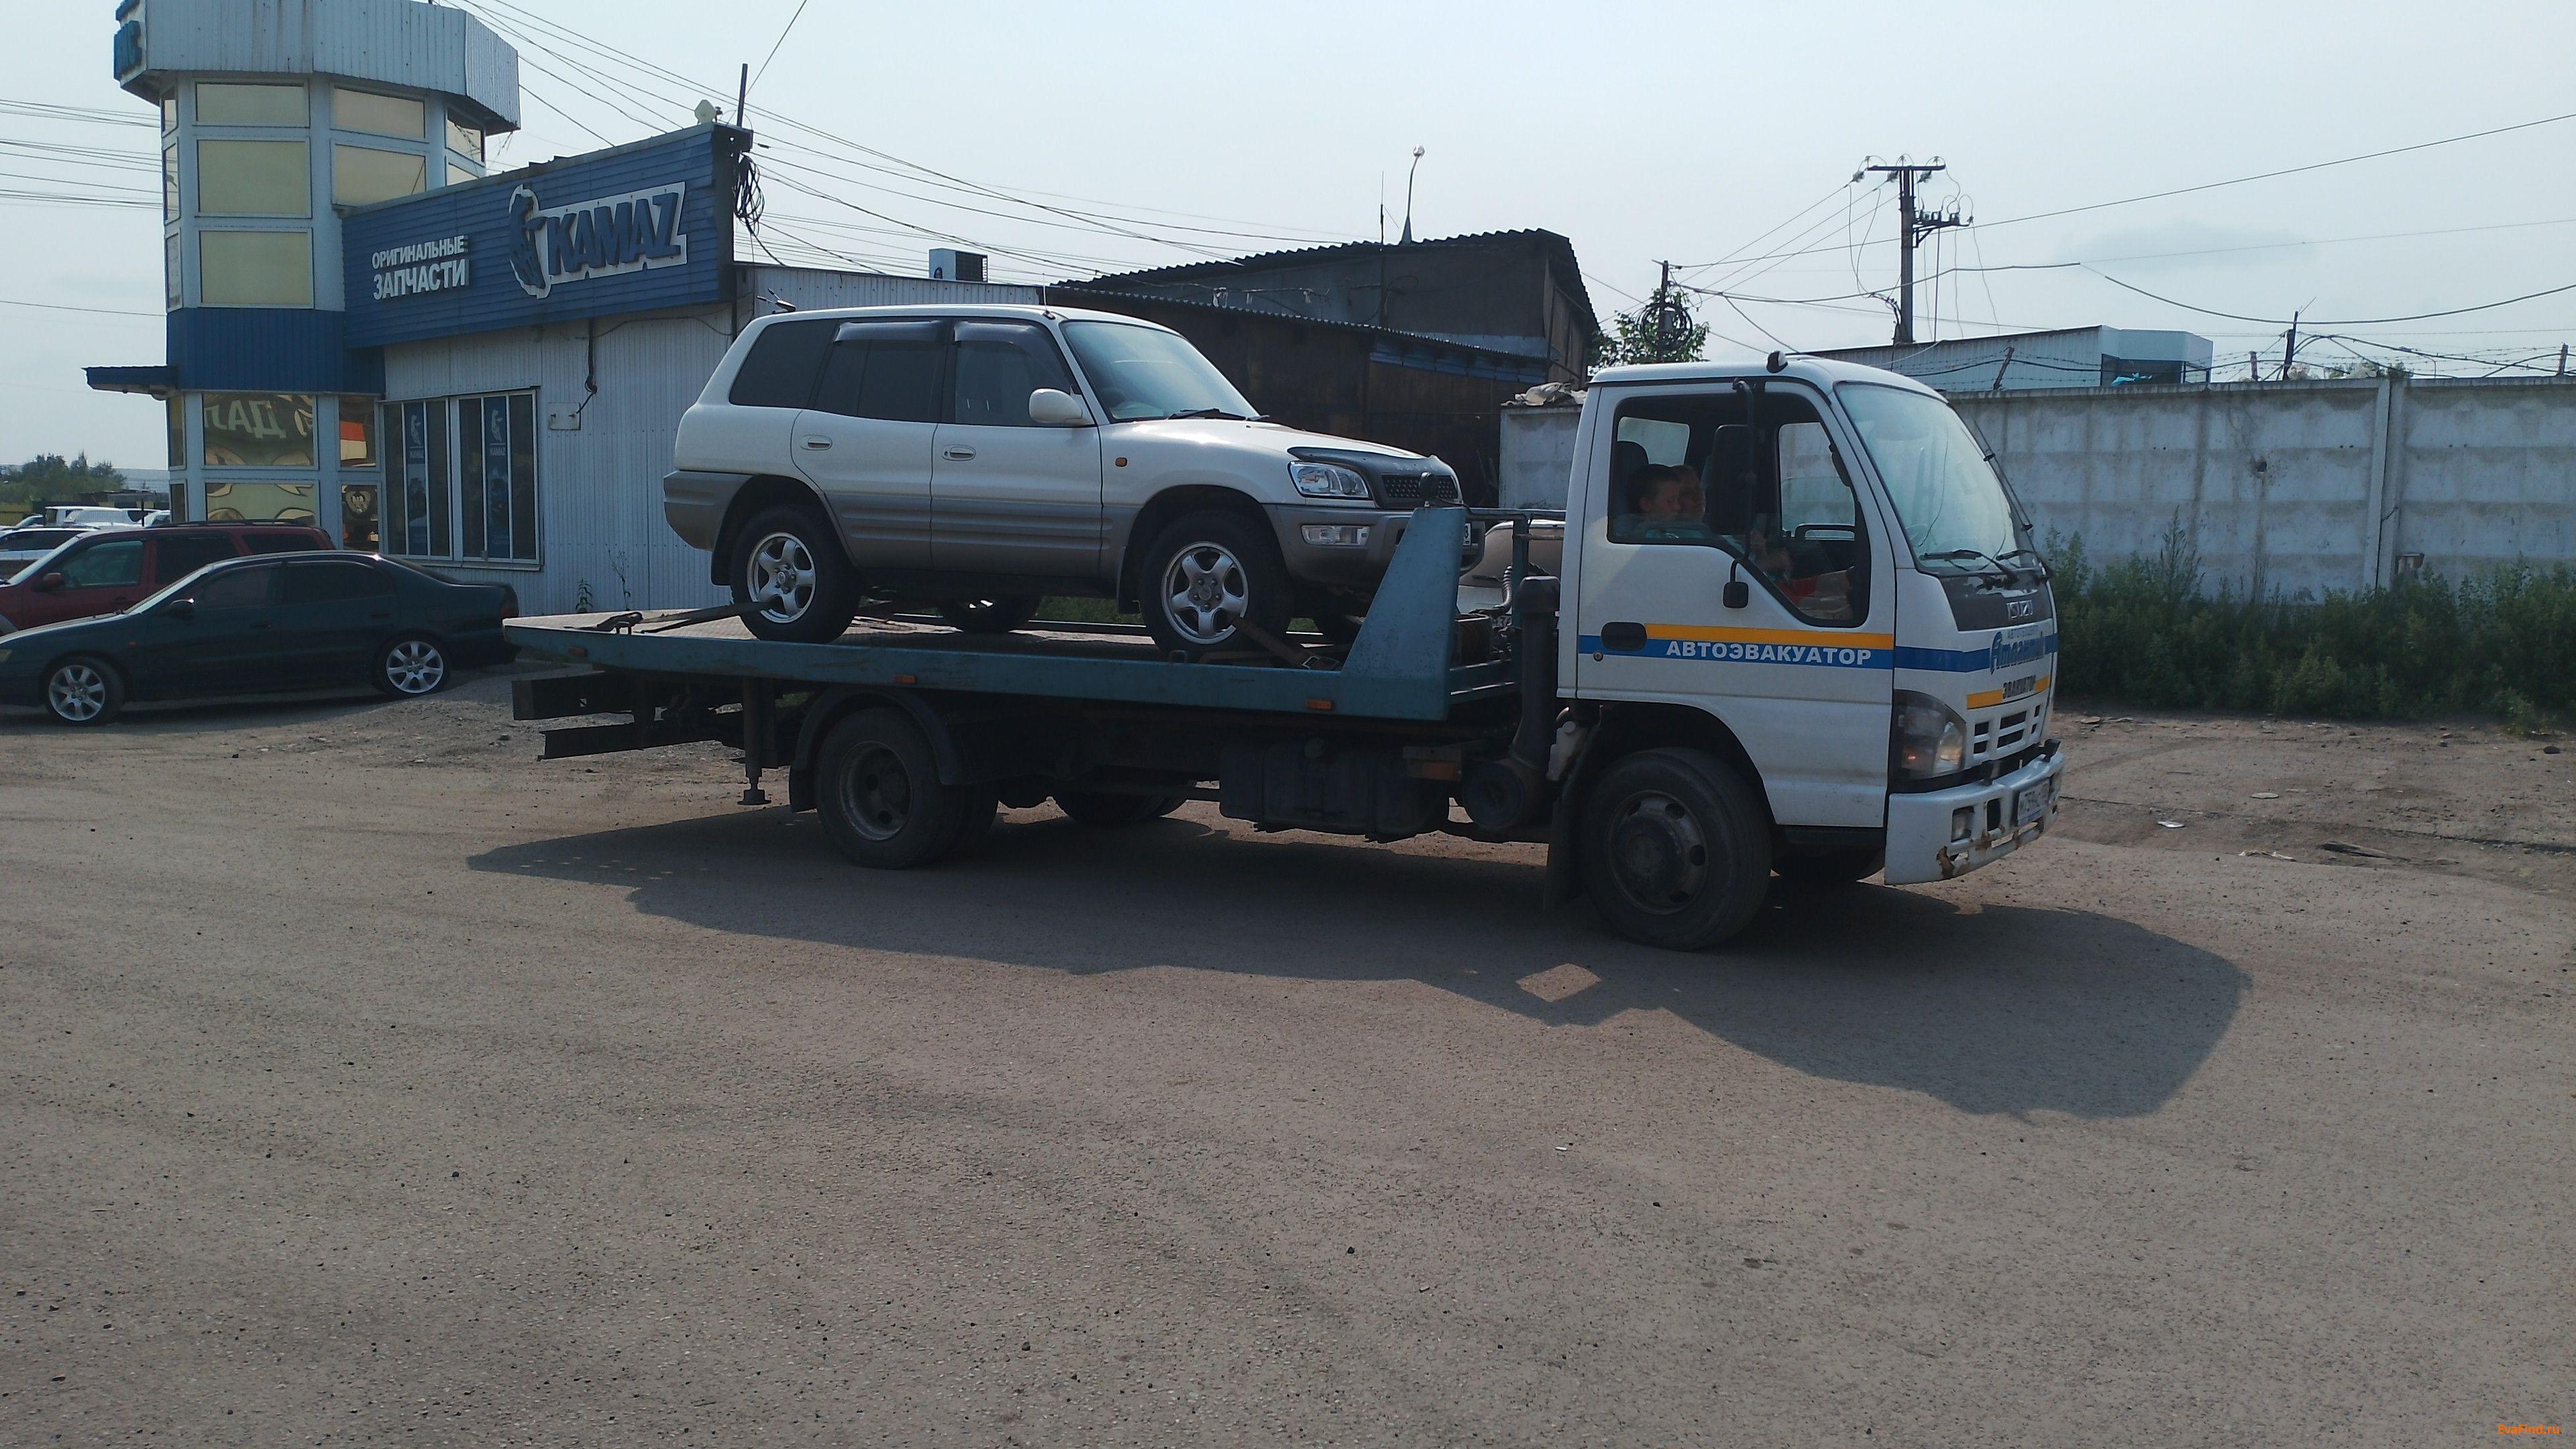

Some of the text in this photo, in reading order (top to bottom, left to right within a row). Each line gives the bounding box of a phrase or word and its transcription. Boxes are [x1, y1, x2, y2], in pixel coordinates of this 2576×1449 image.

[372, 235, 465, 270] ОРИГИНАЛЬНЫЕ
[547, 192, 682, 276] KAMAZ
[374, 260, 466, 301] ЗАПЧАСТИ
[1666, 641, 1872, 665] АВТОЭВАКУАТОР
